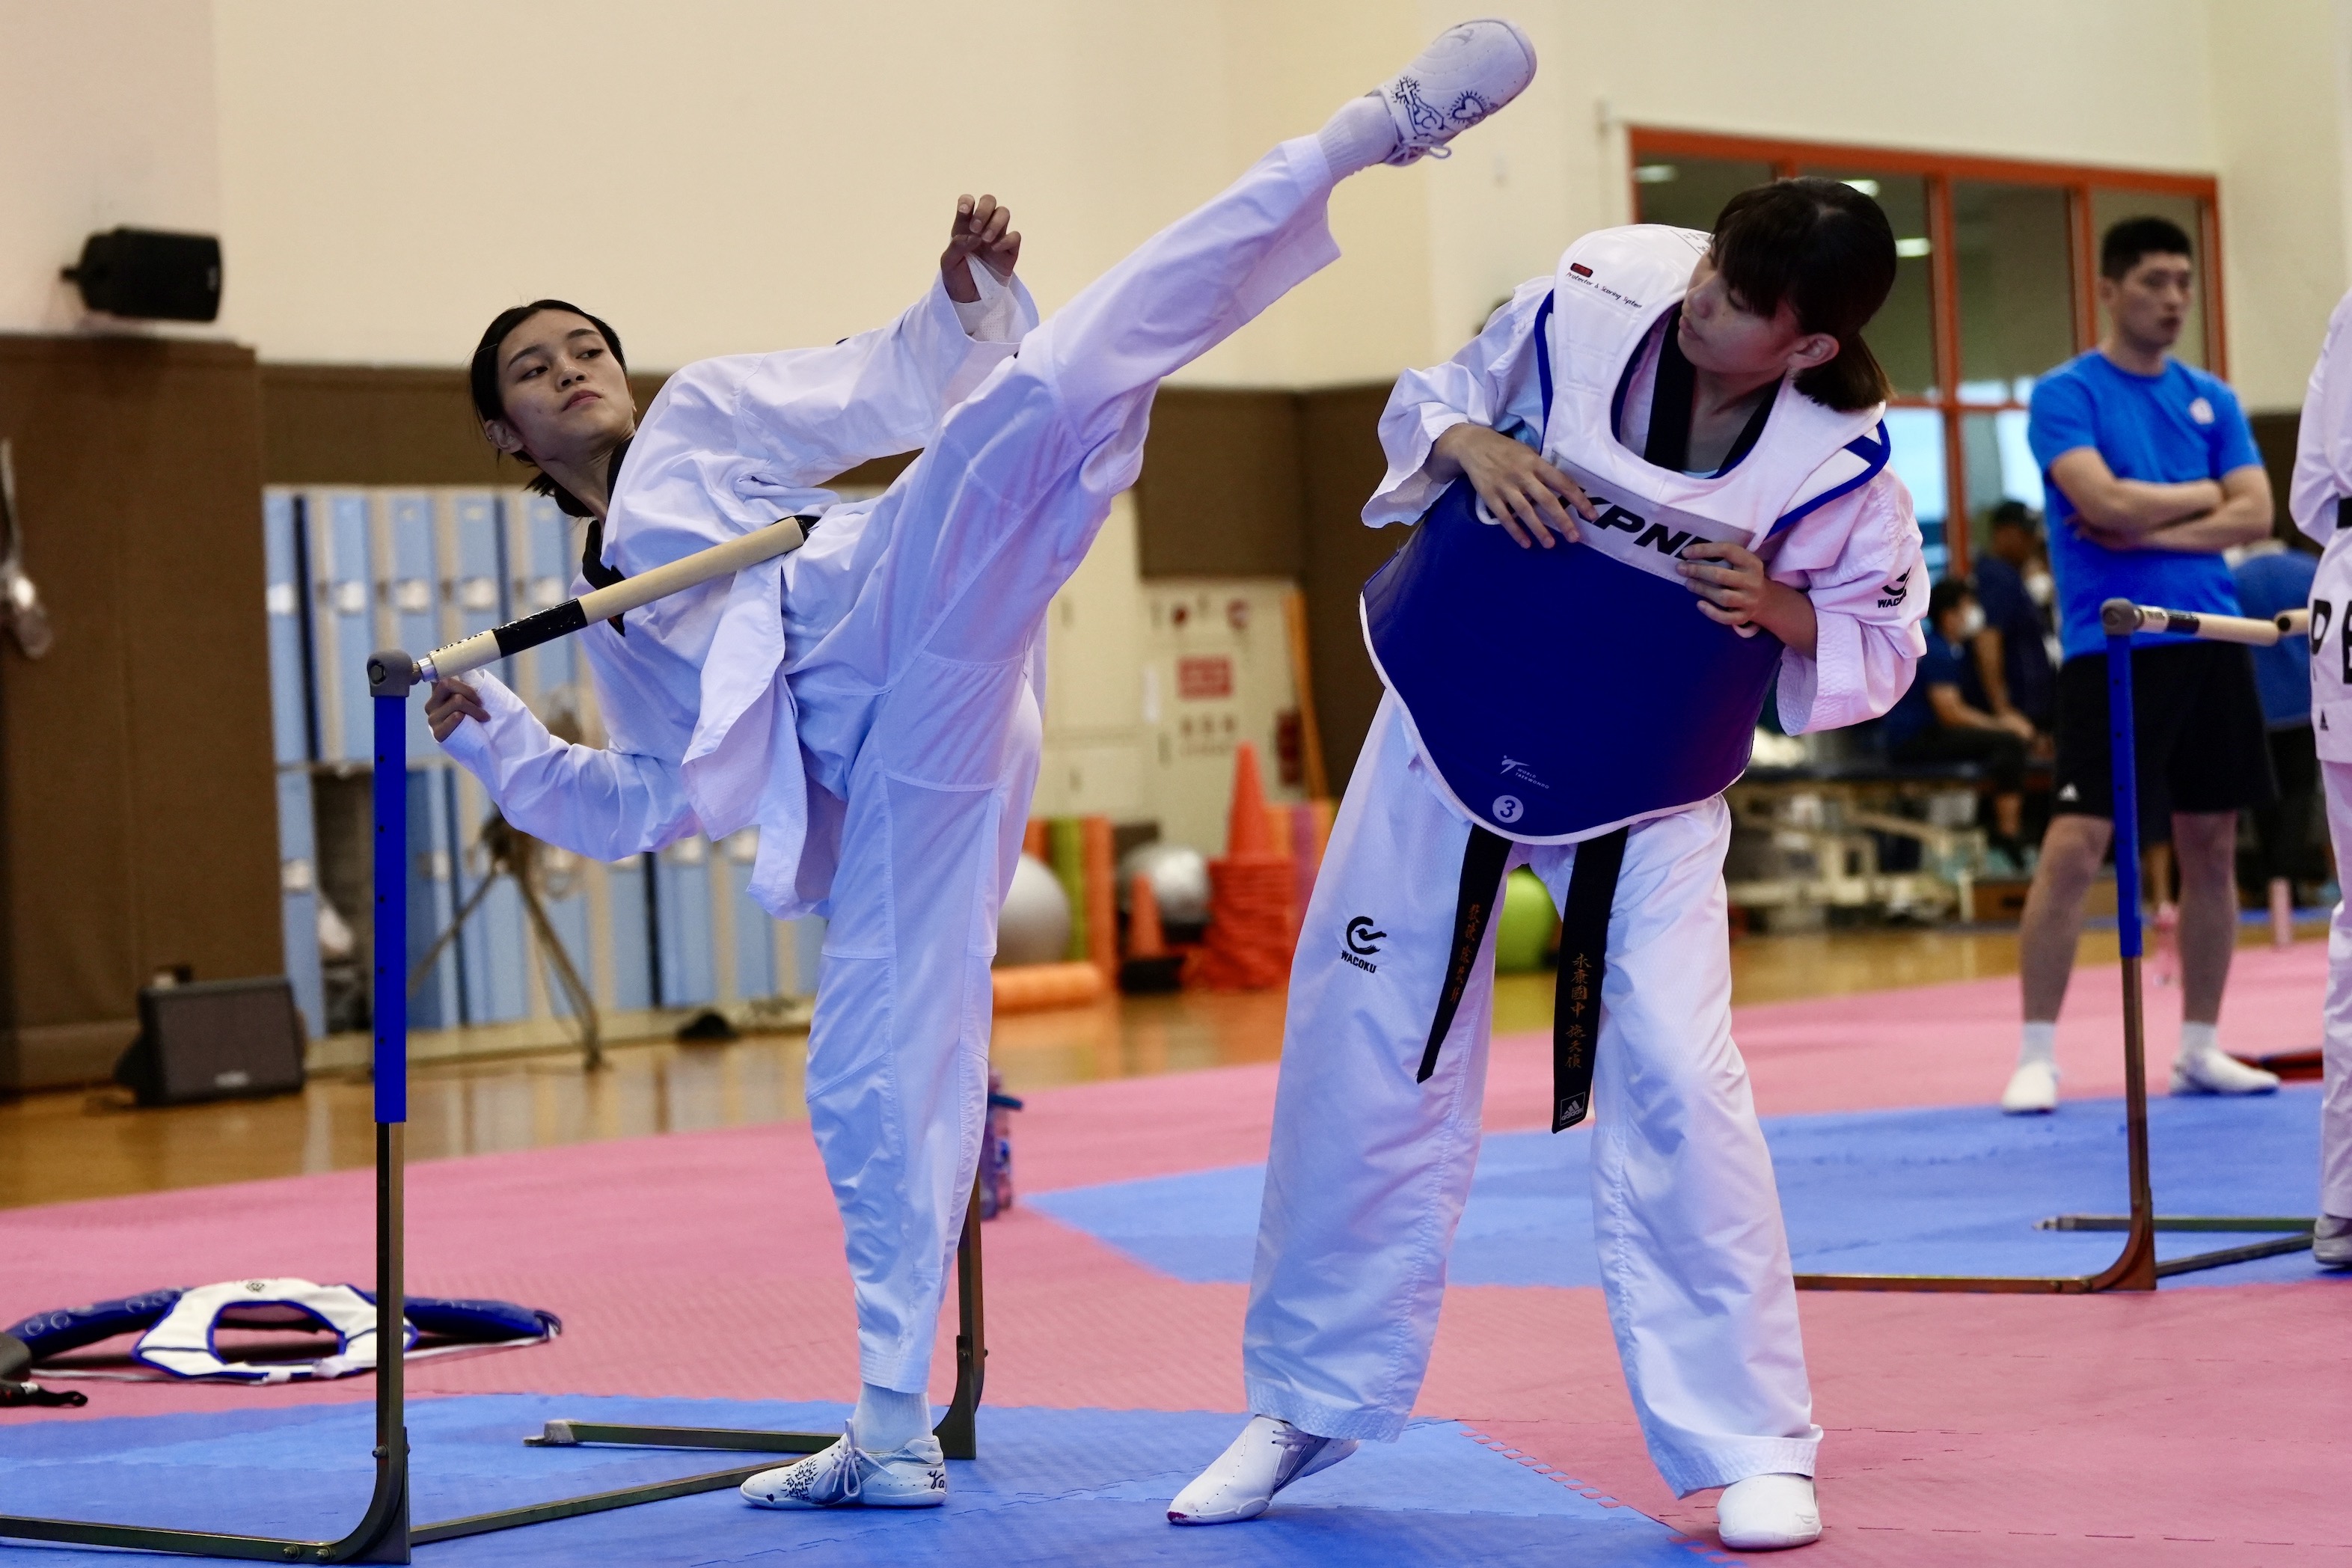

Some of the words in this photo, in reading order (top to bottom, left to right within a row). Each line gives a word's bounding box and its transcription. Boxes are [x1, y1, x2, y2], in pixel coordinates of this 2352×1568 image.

[1566, 272, 1593, 286] Protector
[1602, 286, 1622, 301] Scoring
[1623, 296, 1643, 308] System
[1515, 772, 1550, 789] TAEKWONDO
[1517, 768, 1537, 779] WORLD
[1500, 799, 1516, 818] 3
[1341, 949, 1377, 974] WACOKU
[1571, 952, 1592, 1018] 永康國中
